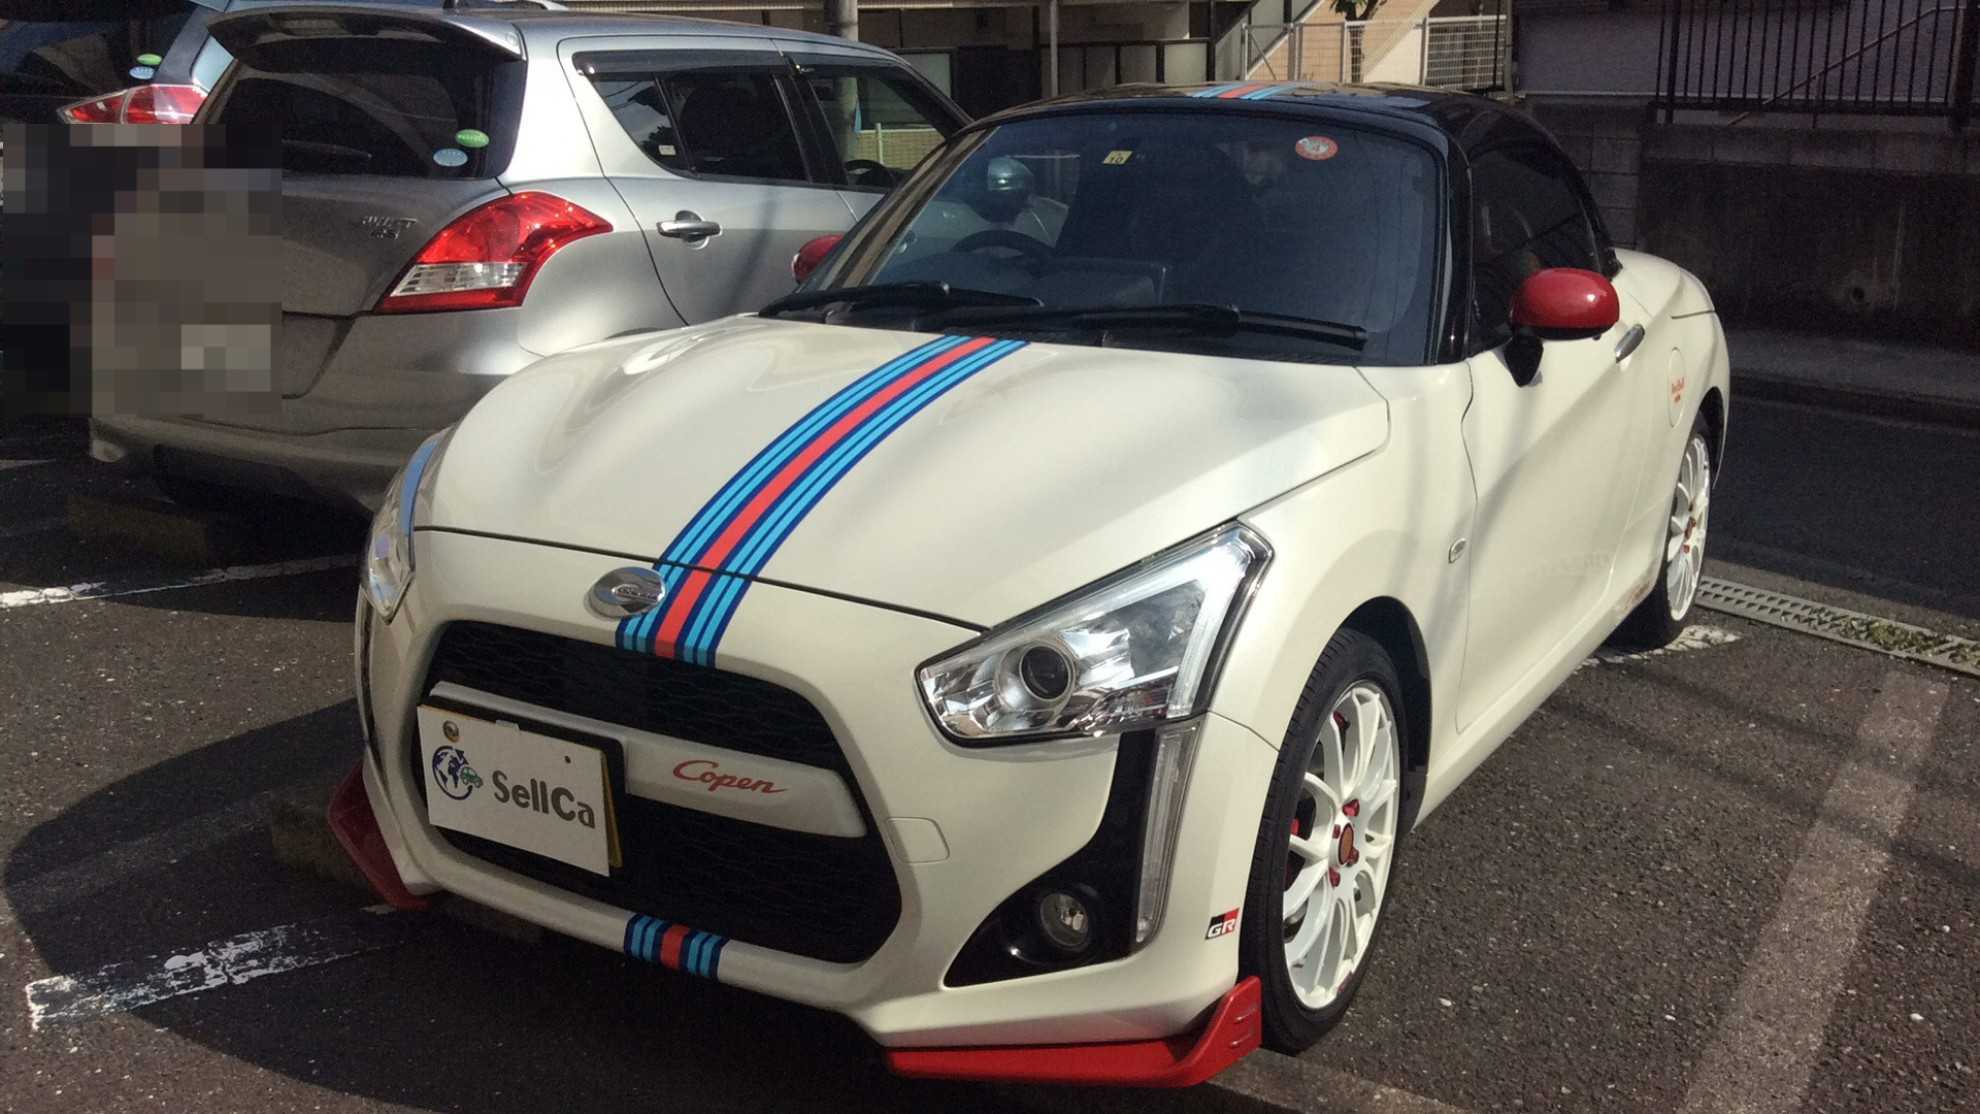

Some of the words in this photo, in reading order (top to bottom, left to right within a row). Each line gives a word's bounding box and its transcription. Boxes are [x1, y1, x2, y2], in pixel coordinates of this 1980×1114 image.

[673, 760, 788, 793] Copen
[492, 770, 596, 829] SellCa
[1207, 918, 1236, 938] GR
